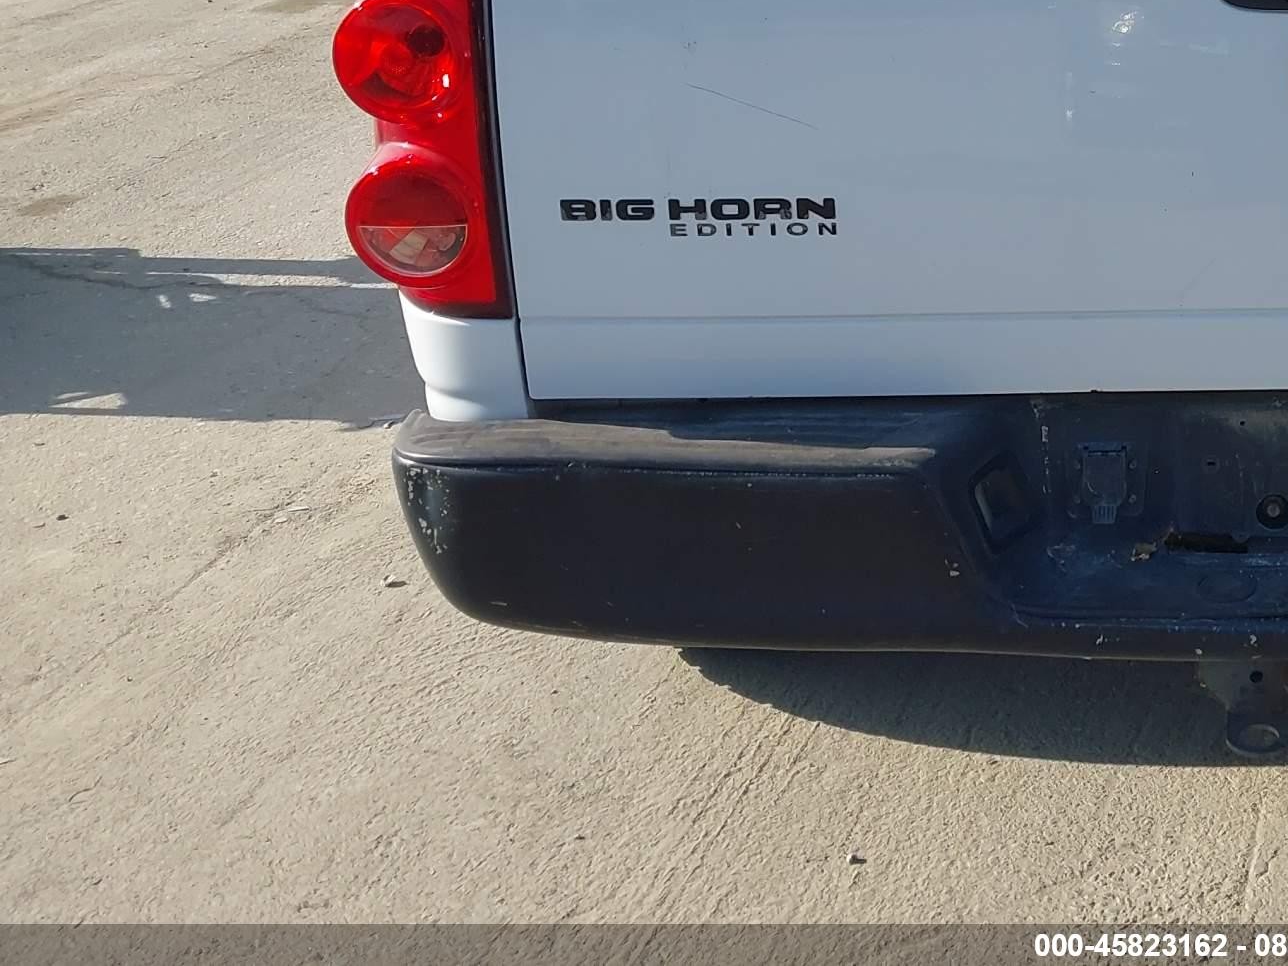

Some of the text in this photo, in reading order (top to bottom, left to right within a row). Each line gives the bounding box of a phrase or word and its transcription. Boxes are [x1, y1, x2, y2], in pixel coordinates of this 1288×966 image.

[560, 197, 837, 221] BIG HORN
[669, 222, 838, 237] EDITION
